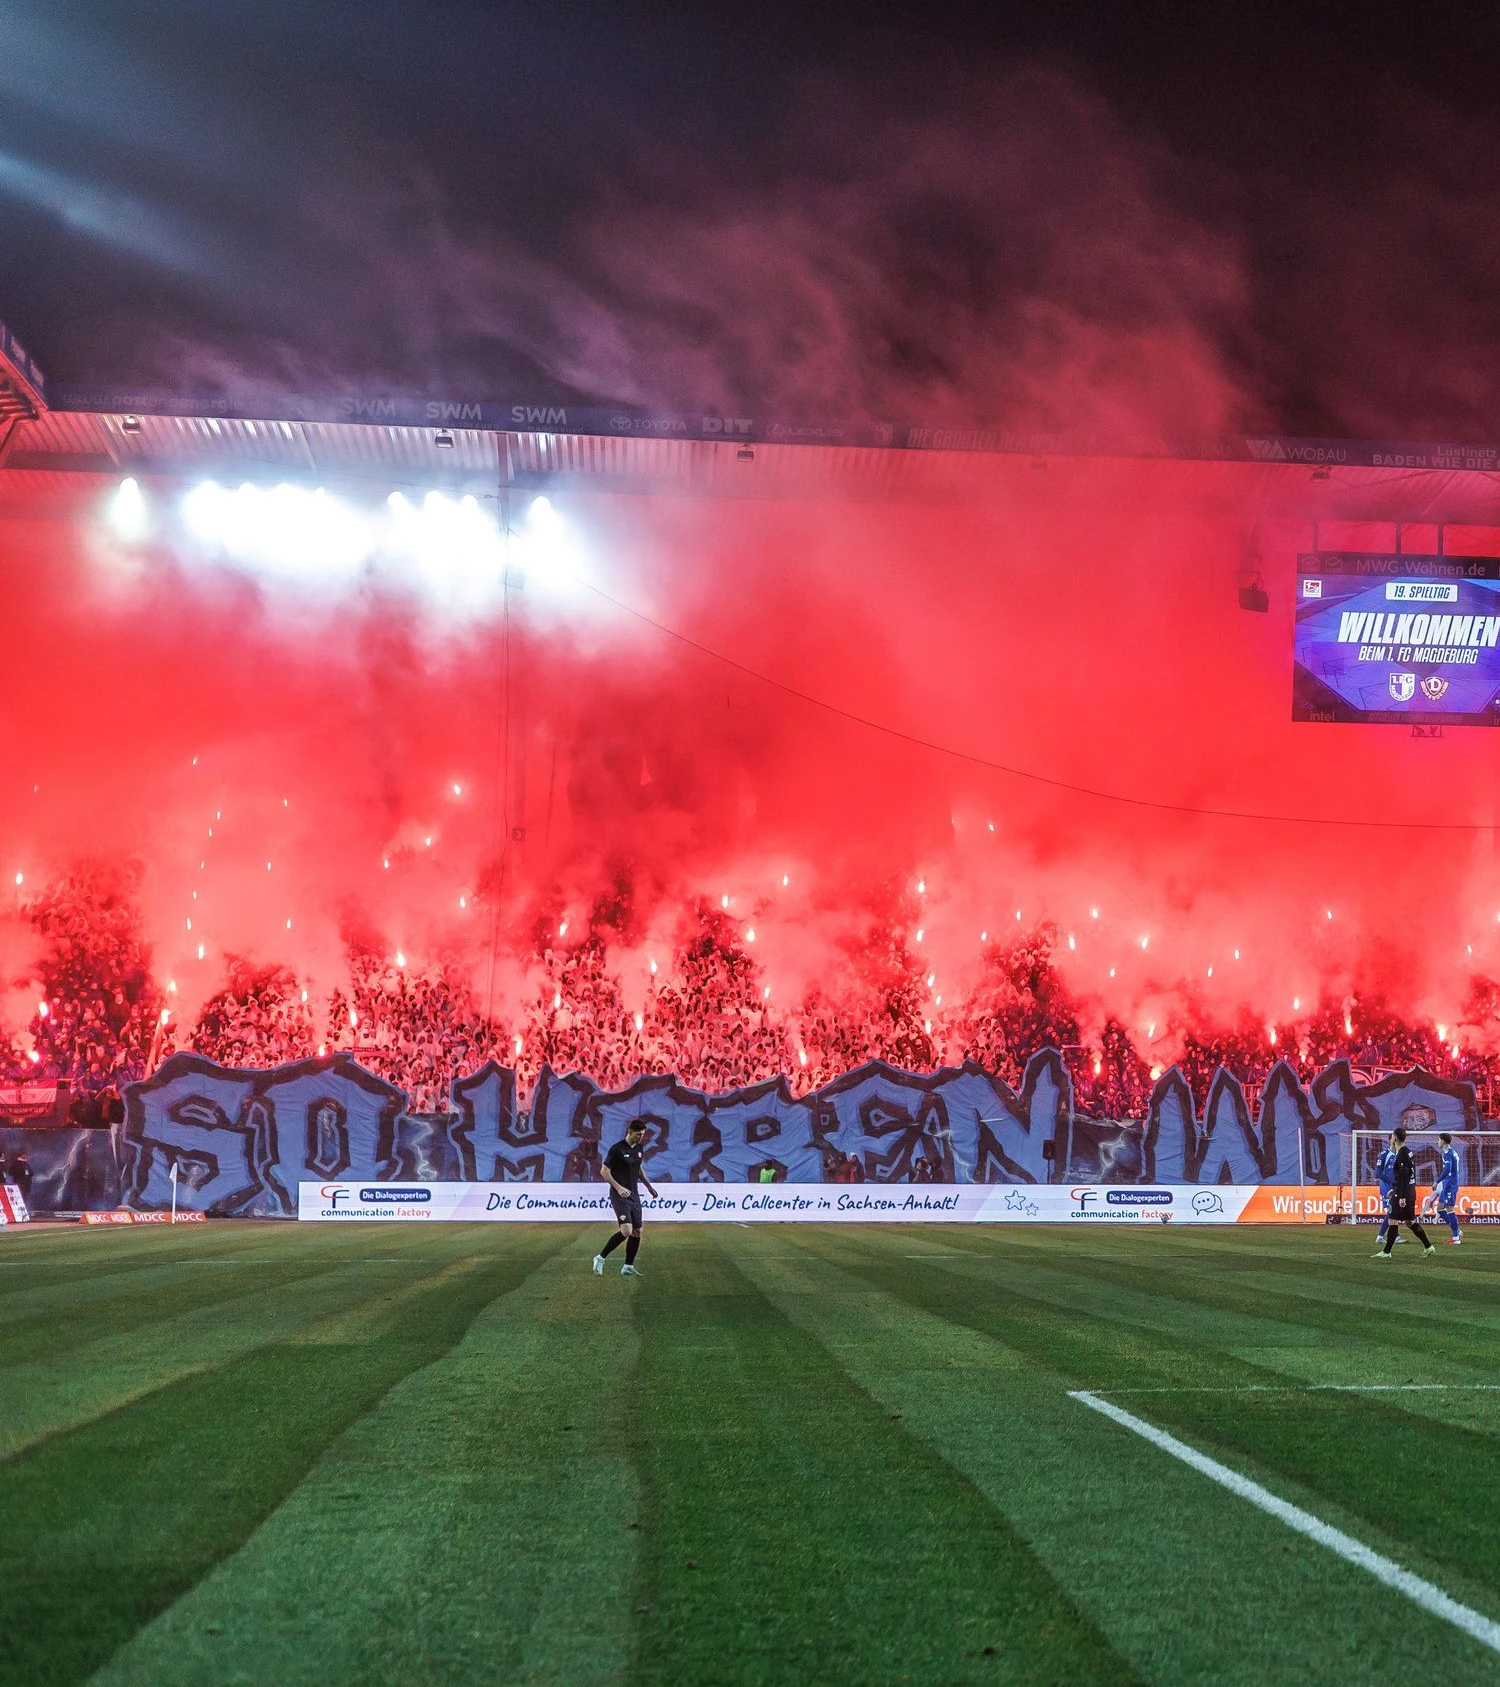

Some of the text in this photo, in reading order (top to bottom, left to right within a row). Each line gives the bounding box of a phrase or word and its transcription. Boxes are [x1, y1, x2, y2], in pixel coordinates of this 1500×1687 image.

[425, 402, 483, 420] SWM
[511, 405, 568, 425] SWM
[634, 419, 687, 431] TOYOTA
[1286, 447, 1347, 462] WOBAU
[1372, 454, 1427, 468] BADEN
[1431, 457, 1461, 469] WIE
[1466, 457, 1492, 470] DIE
[1356, 559, 1486, 577] MWG-Wohnen.de
[1394, 585, 1451, 599] 19. SPIELTAG
[1358, 645, 1479, 665] BEIM 1. FC MAGDEBURG
[362, 1190, 428, 1203] Die Dialogexperten
[486, 1192, 511, 1211] Die
[702, 1193, 737, 1211] Dein
[741, 1193, 814, 1210] Callcenter
[818, 1196, 831, 1210] in
[837, 1193, 960, 1211] Sachsen-Anhalt!
[1109, 1194, 1170, 1204] Die Dialogexperten
[1273, 1196, 1299, 1213] Wir
[134, 1213, 166, 1222] MDCC
[321, 1208, 431, 1218] communication factory
[1070, 1210, 1139, 1219] communication
